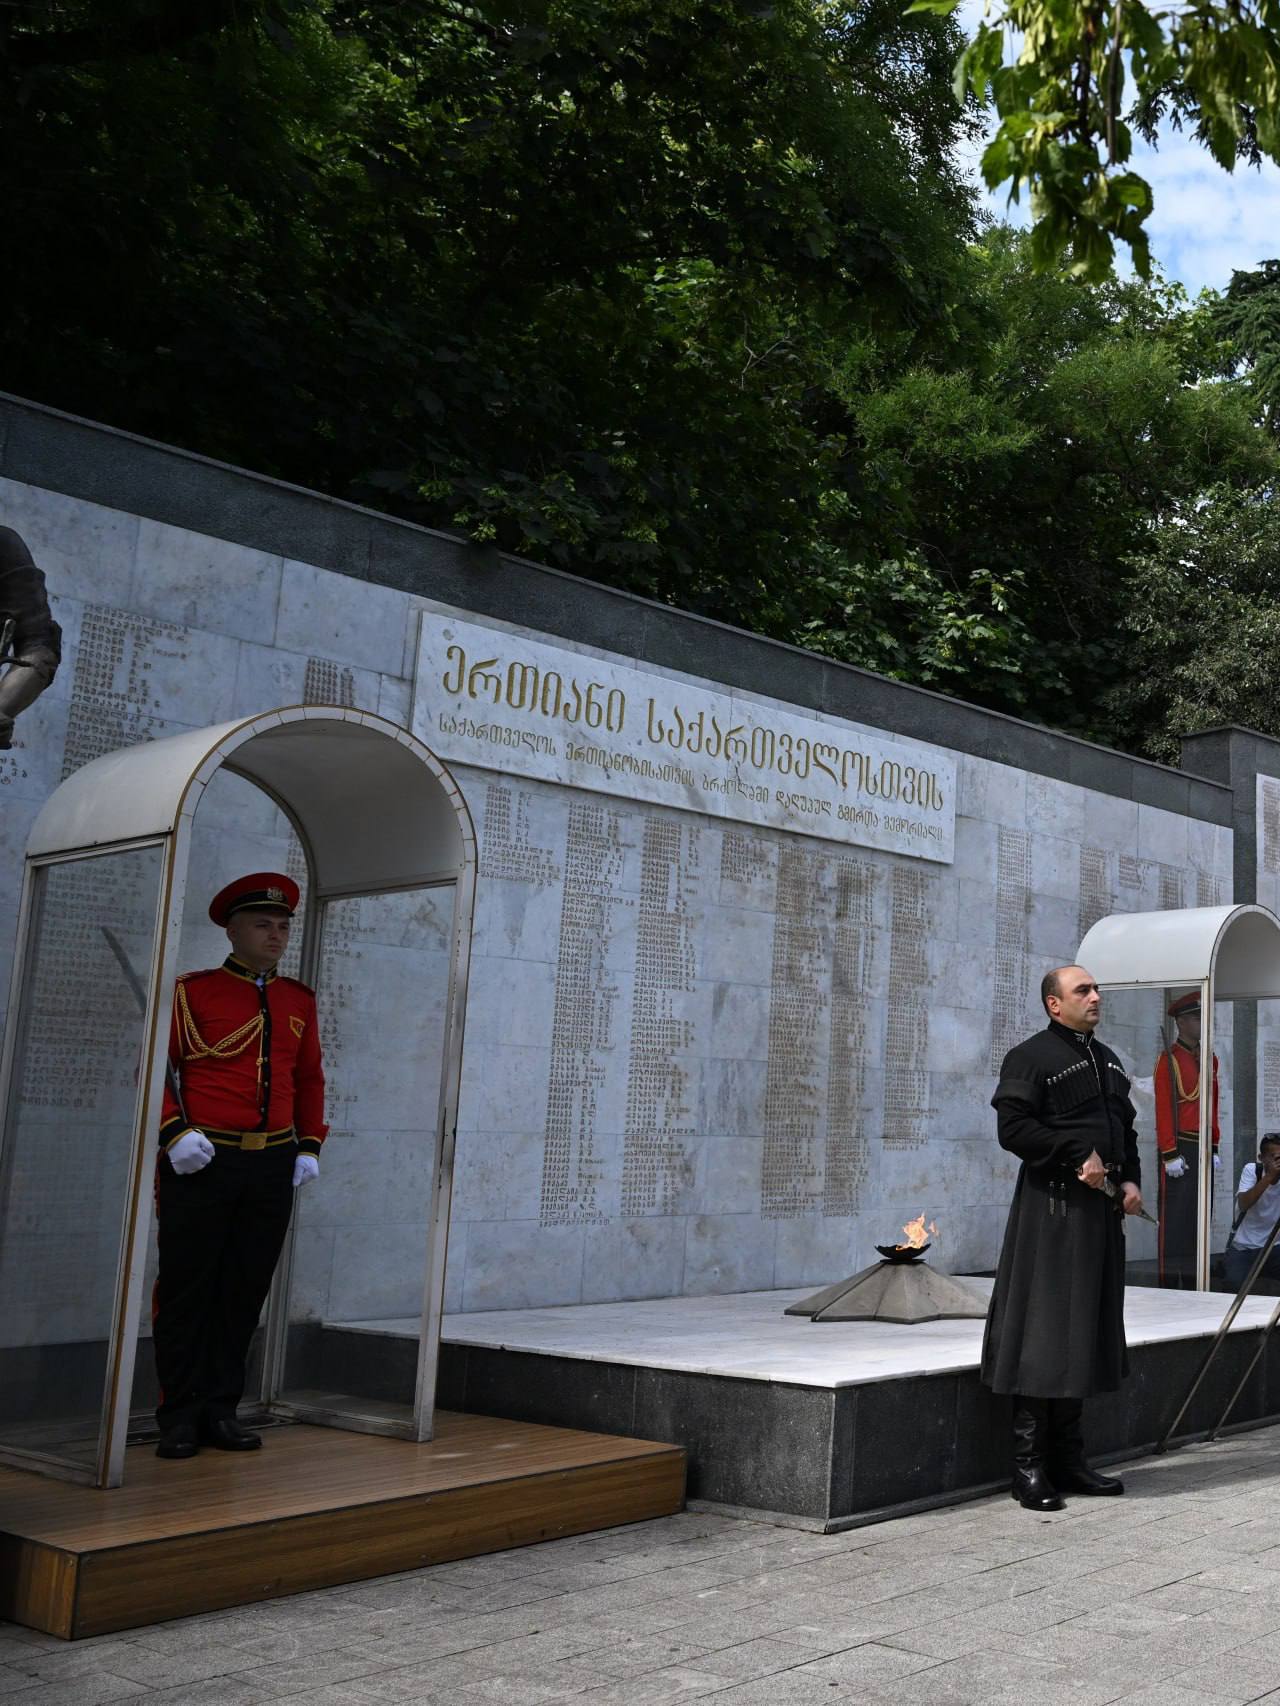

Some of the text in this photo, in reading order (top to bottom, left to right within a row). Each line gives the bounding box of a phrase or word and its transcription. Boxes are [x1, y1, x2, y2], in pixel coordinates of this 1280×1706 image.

[439, 712, 944, 841] საქართველოს ერთიანობისათვის ბრძოლაში დაღუპულ გმირთა მემორიალი
[443, 645, 626, 734] ერთიანი
[647, 698, 944, 811] საქართველოსთვის
